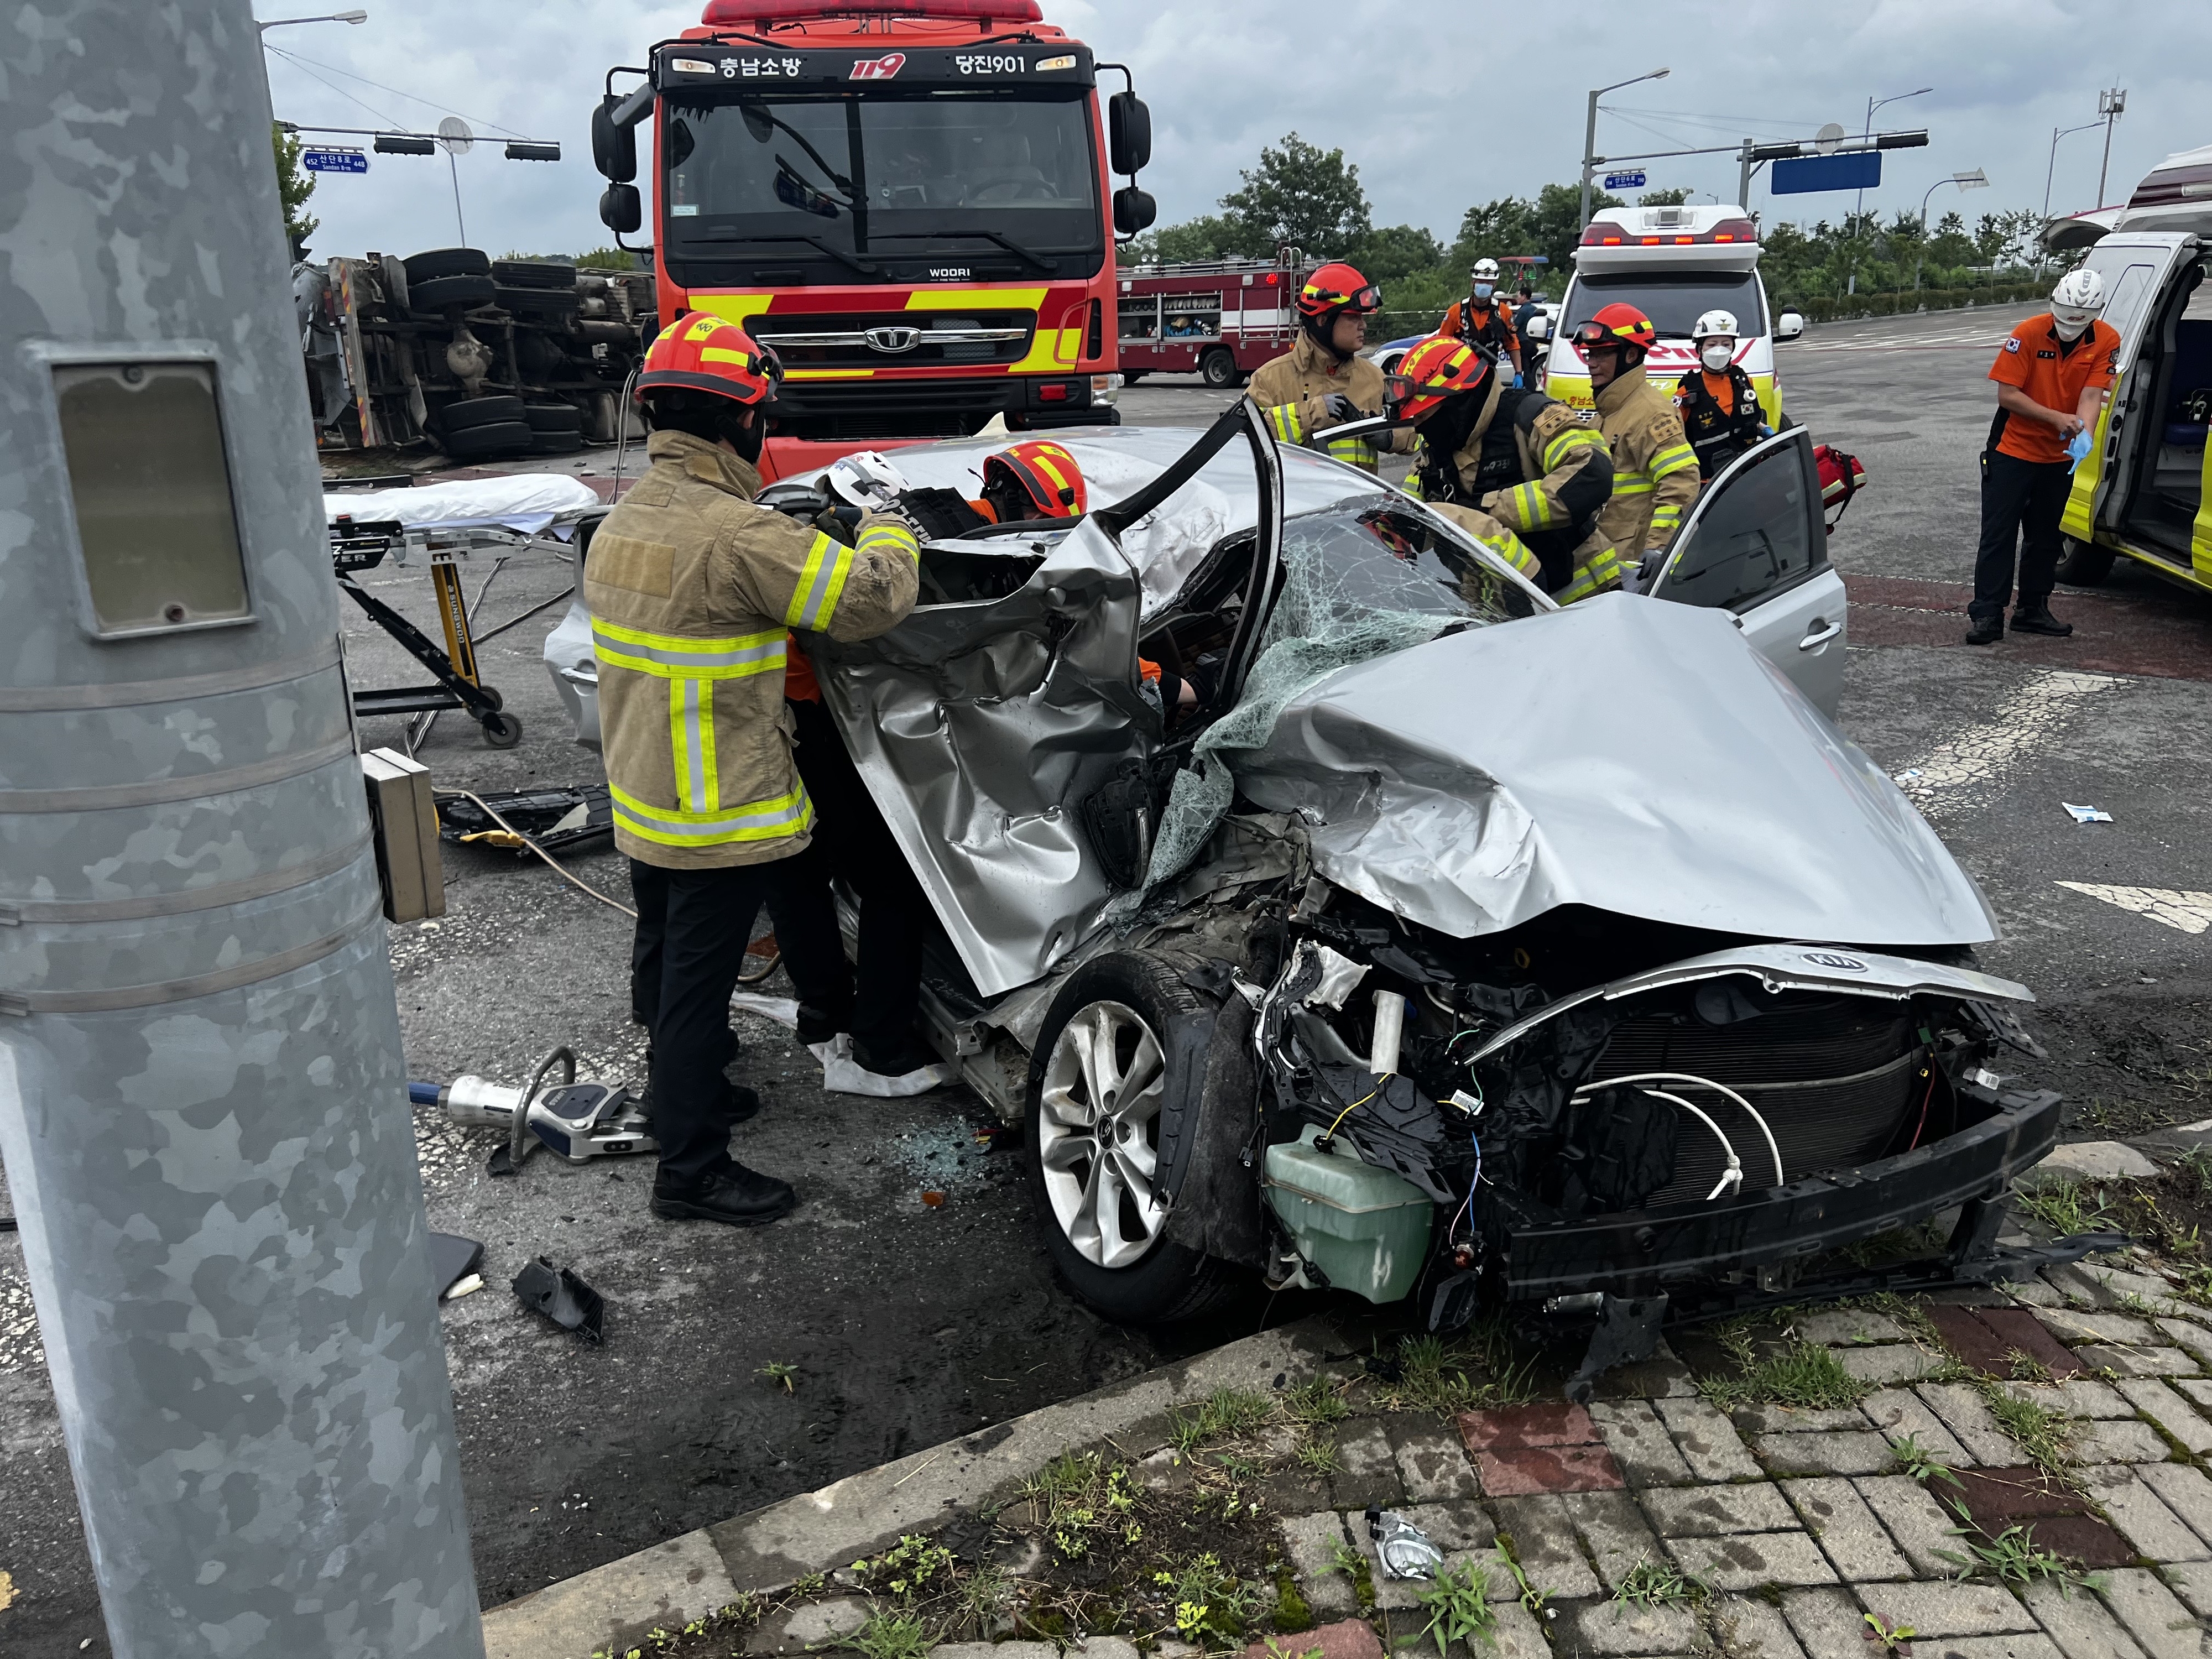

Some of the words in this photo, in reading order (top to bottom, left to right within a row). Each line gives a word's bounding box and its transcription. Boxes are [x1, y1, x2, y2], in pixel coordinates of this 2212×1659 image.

[720, 58, 802, 79] 충남소방
[848, 52, 907, 80] 119
[955, 55, 1025, 75] 당진901
[320, 154, 352, 164] 산단8로
[929, 268, 971, 277] WOORI
[1809, 953, 1860, 968] KIA
